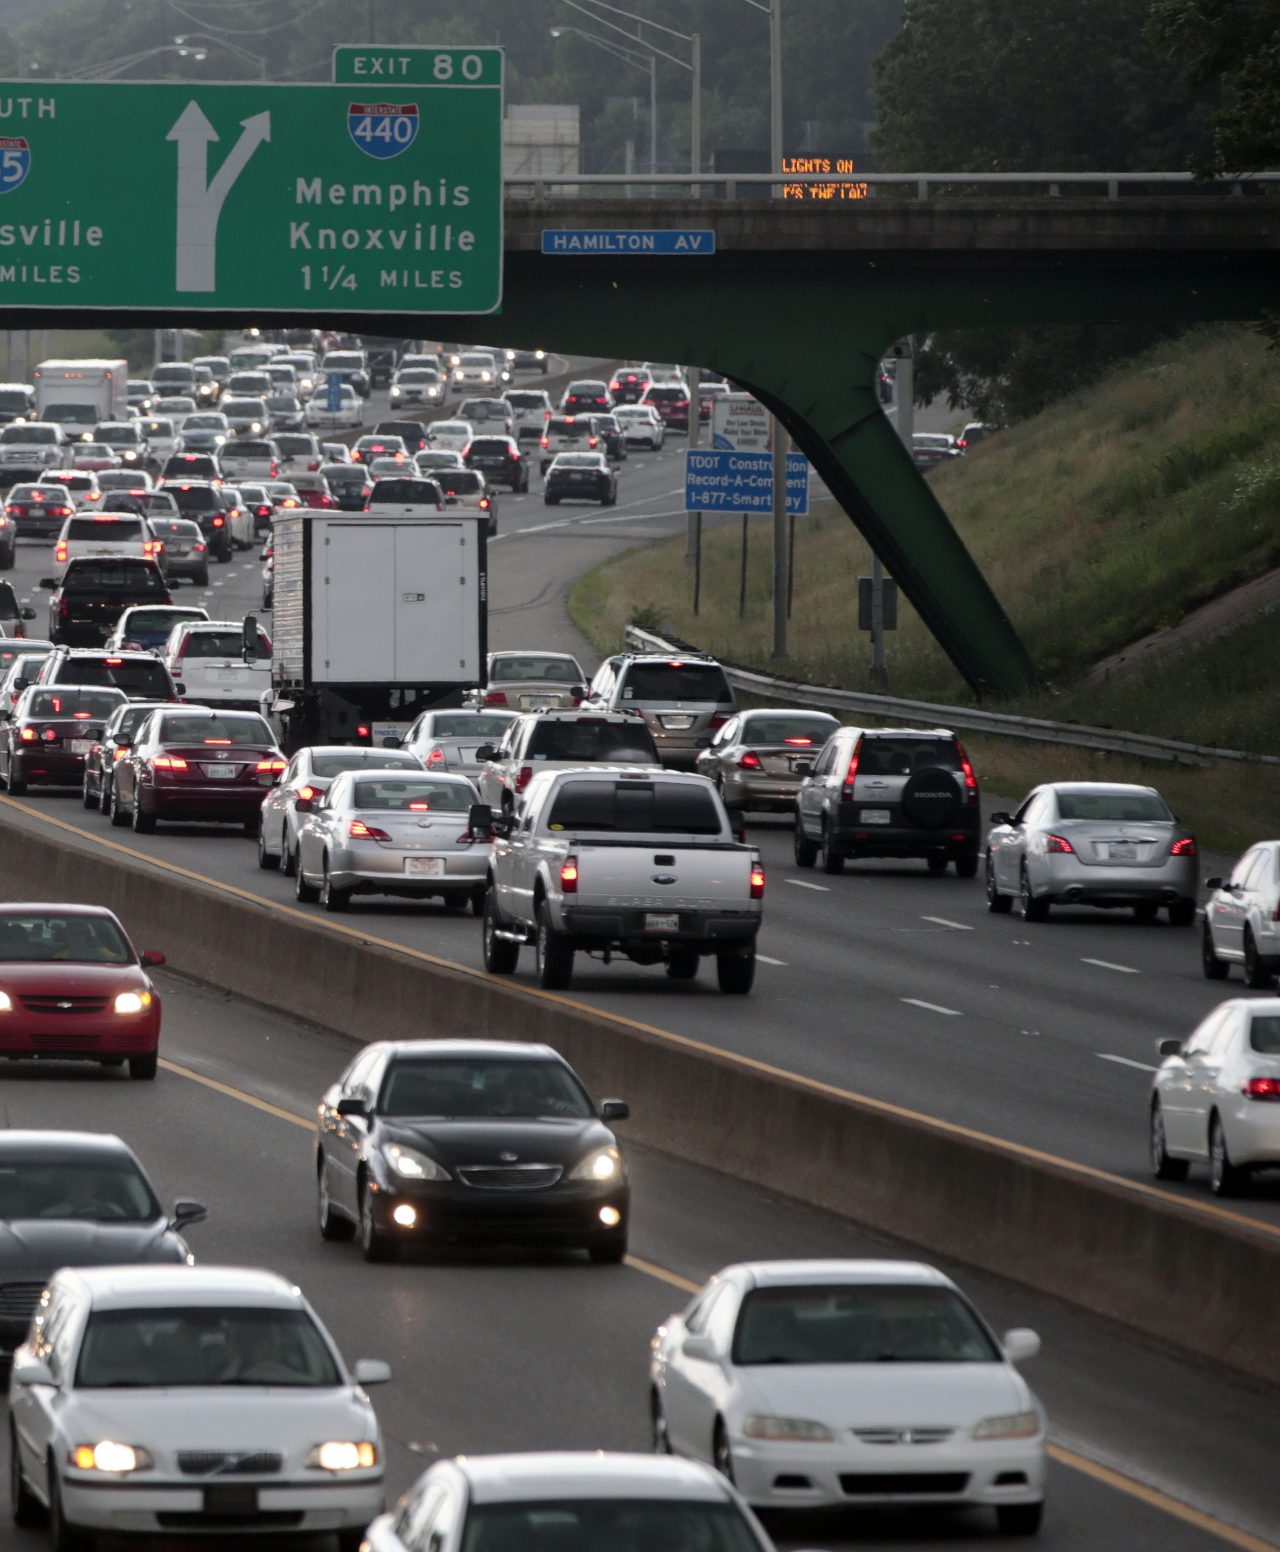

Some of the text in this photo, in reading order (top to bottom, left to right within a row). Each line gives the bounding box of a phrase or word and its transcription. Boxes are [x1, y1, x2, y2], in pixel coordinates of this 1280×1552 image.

[353, 54, 483, 80] EXIT 80
[354, 117, 412, 143] 440
[782, 158, 853, 173] LIGHTS ON
[295, 177, 470, 212] Memphis
[290, 222, 475, 251] Knoxville
[554, 235, 702, 249] HAMILTON AV
[0, 265, 81, 283] MILES
[380, 270, 463, 288] MILES
[689, 456, 720, 468] TDOT
[914, 791, 953, 799] HONDA
